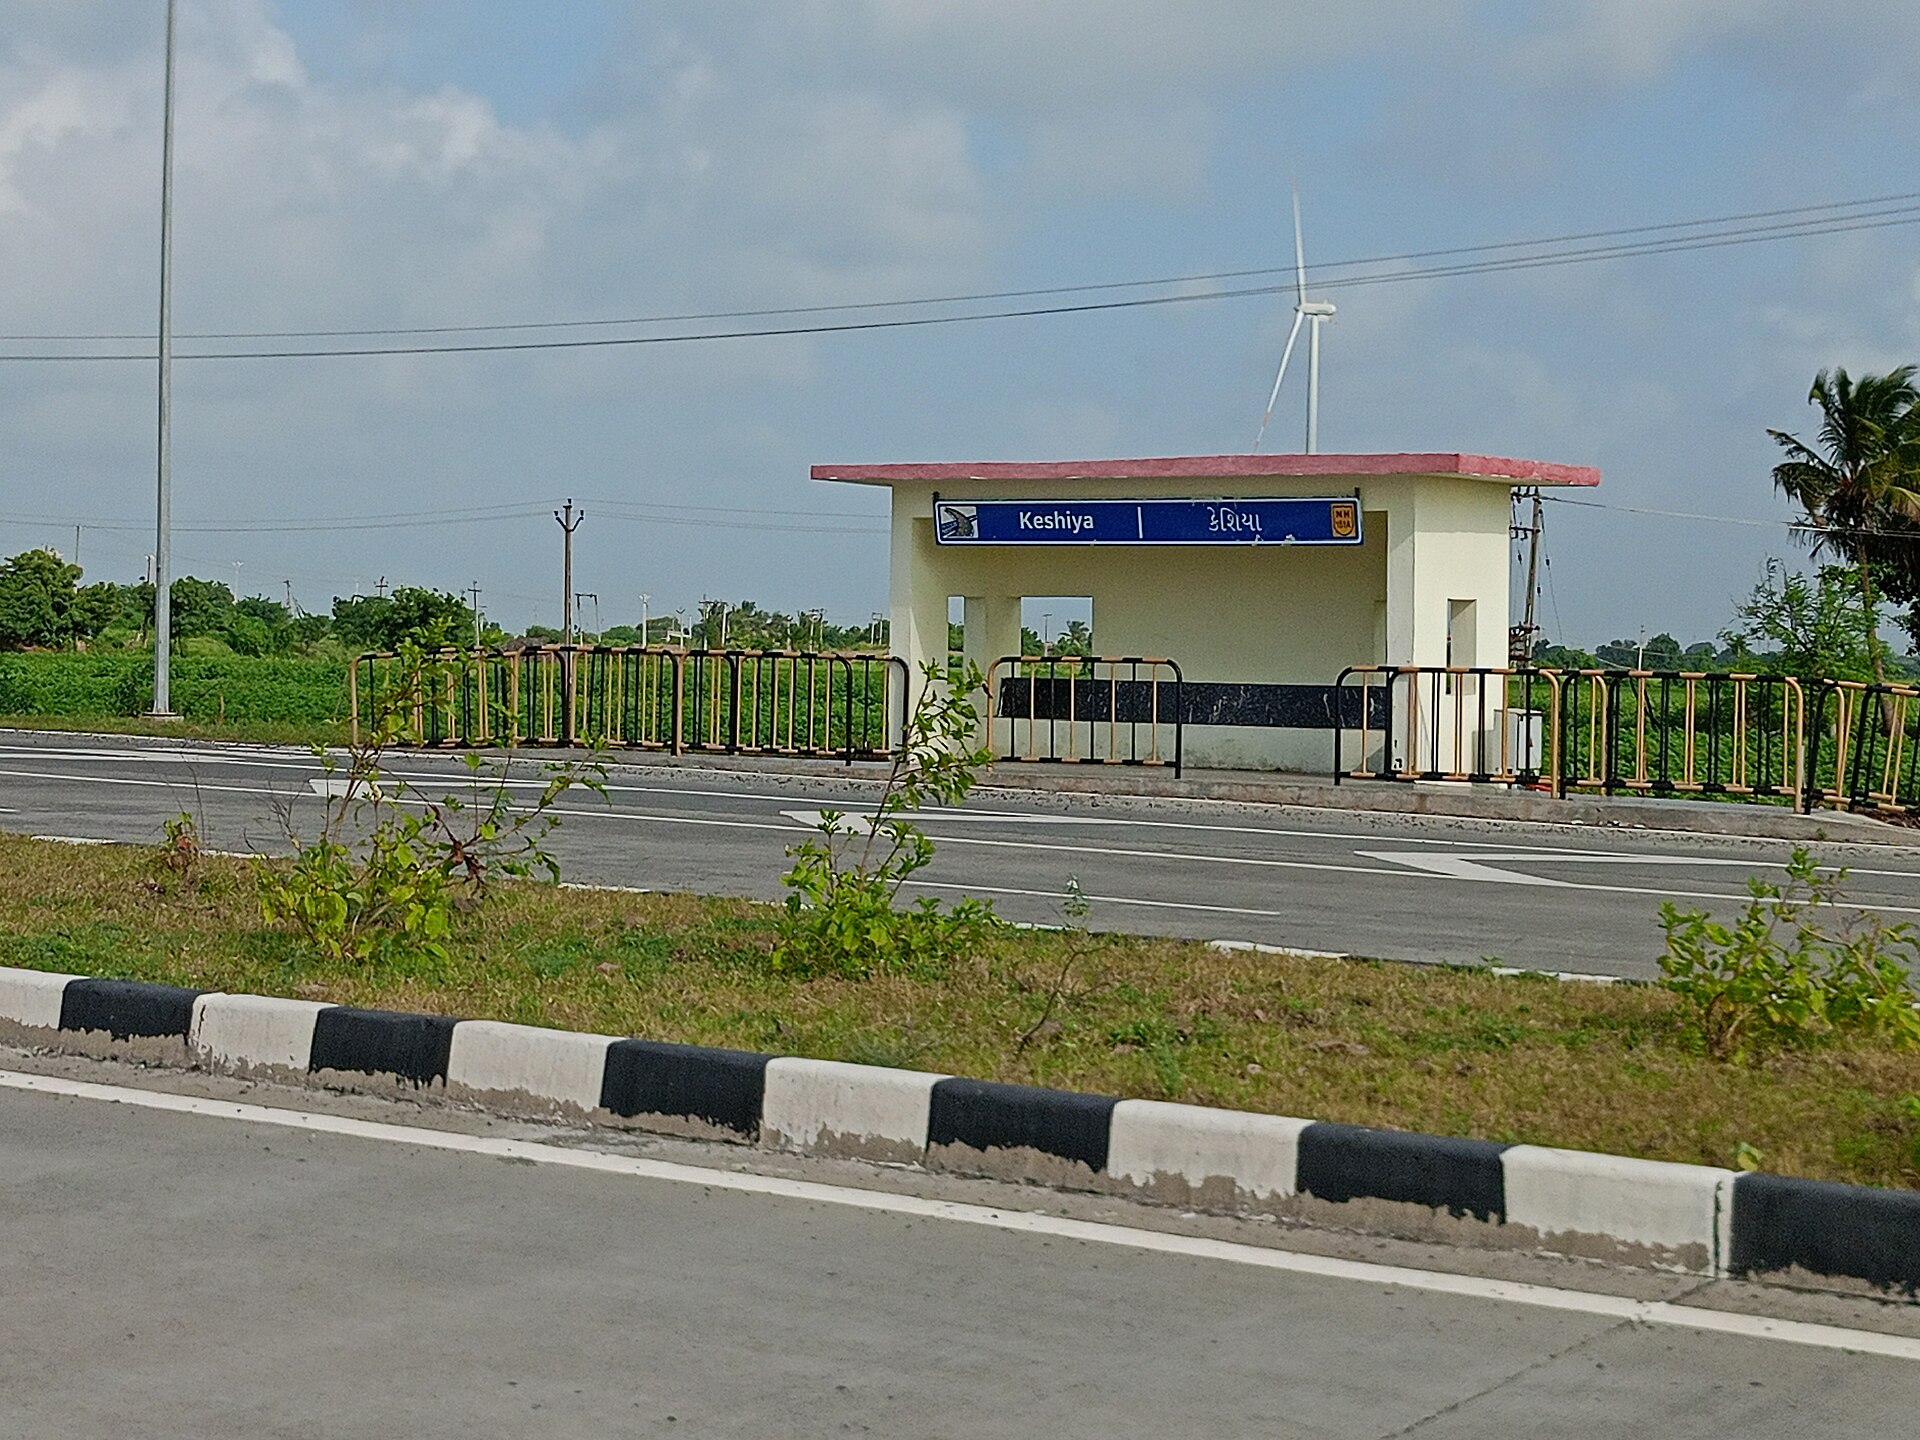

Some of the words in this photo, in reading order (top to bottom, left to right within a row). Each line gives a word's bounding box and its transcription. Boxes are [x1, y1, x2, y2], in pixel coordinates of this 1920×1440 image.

[1019, 511, 1094, 534] Keshiya
[1207, 506, 1263, 532] કેશિયા
[1335, 510, 1350, 518] NH
